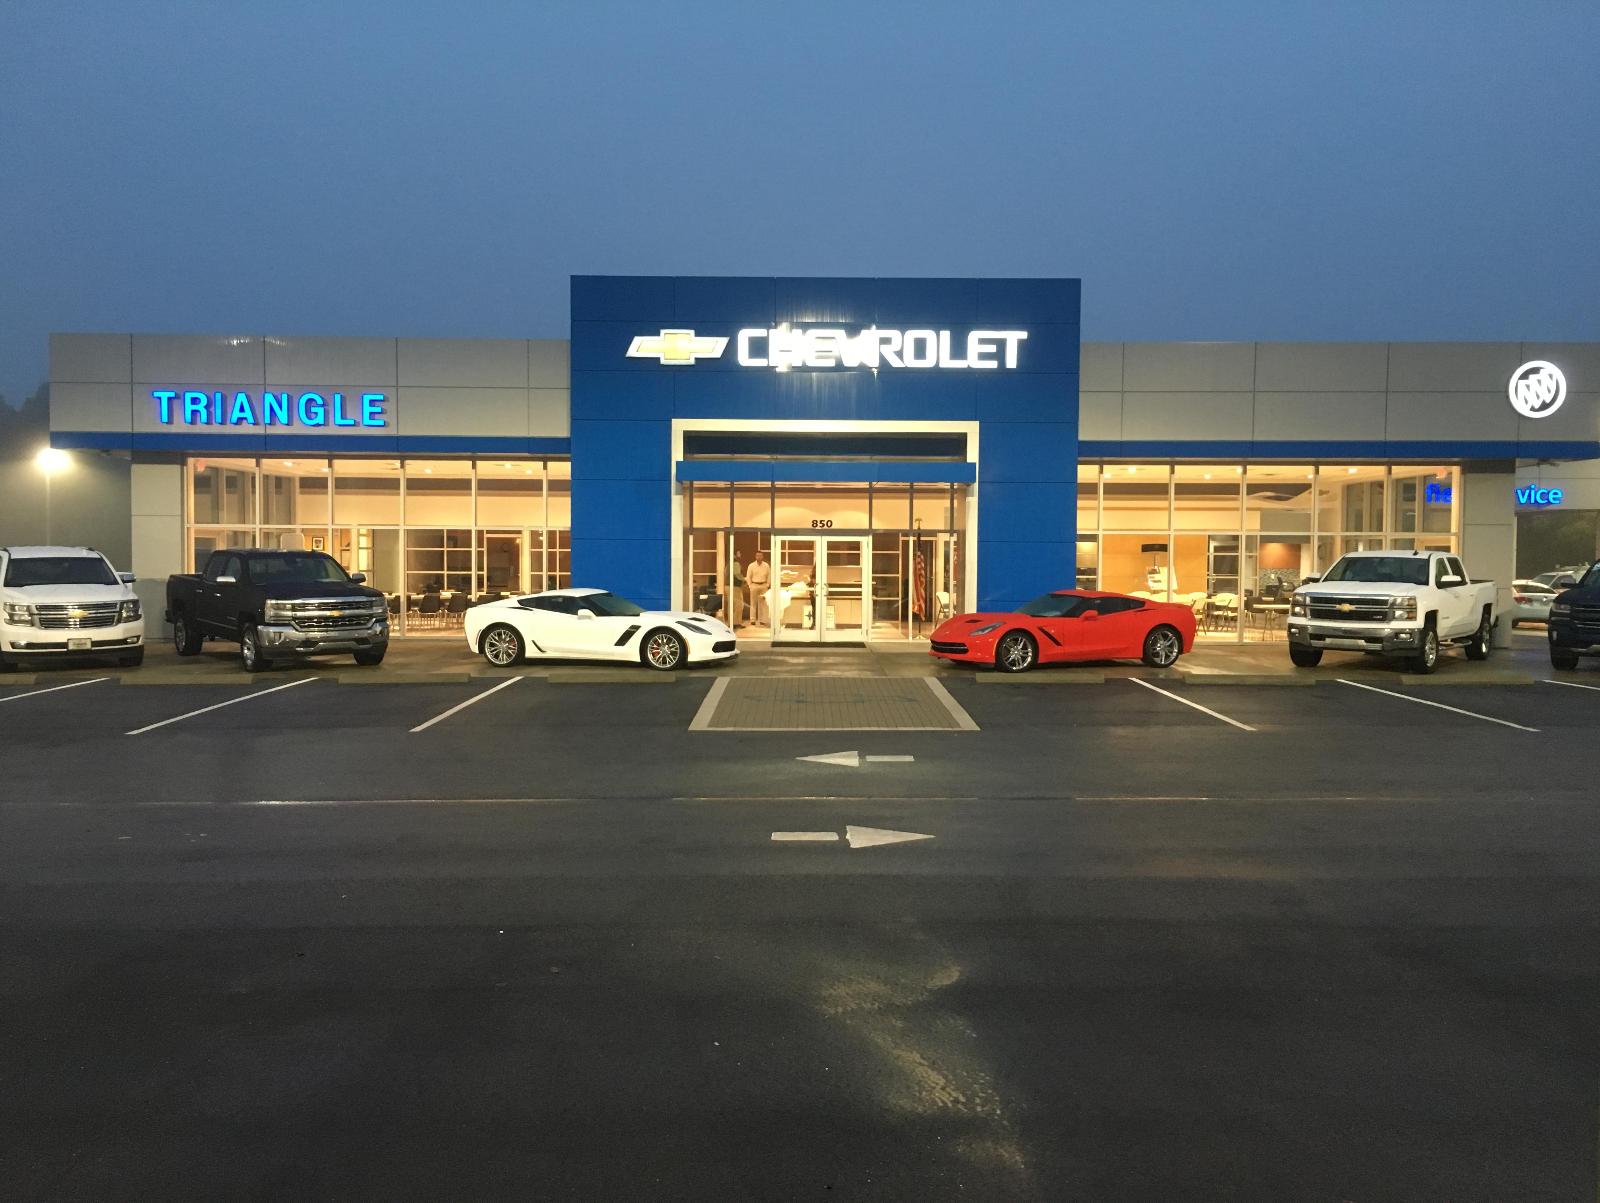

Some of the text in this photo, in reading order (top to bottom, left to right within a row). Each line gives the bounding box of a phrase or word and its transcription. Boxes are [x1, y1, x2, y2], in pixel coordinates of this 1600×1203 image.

[737, 328, 1028, 369] CHEVROLET
[152, 390, 387, 427] TRIANGLE
[1514, 484, 1563, 504] vice
[811, 519, 833, 529] 850
